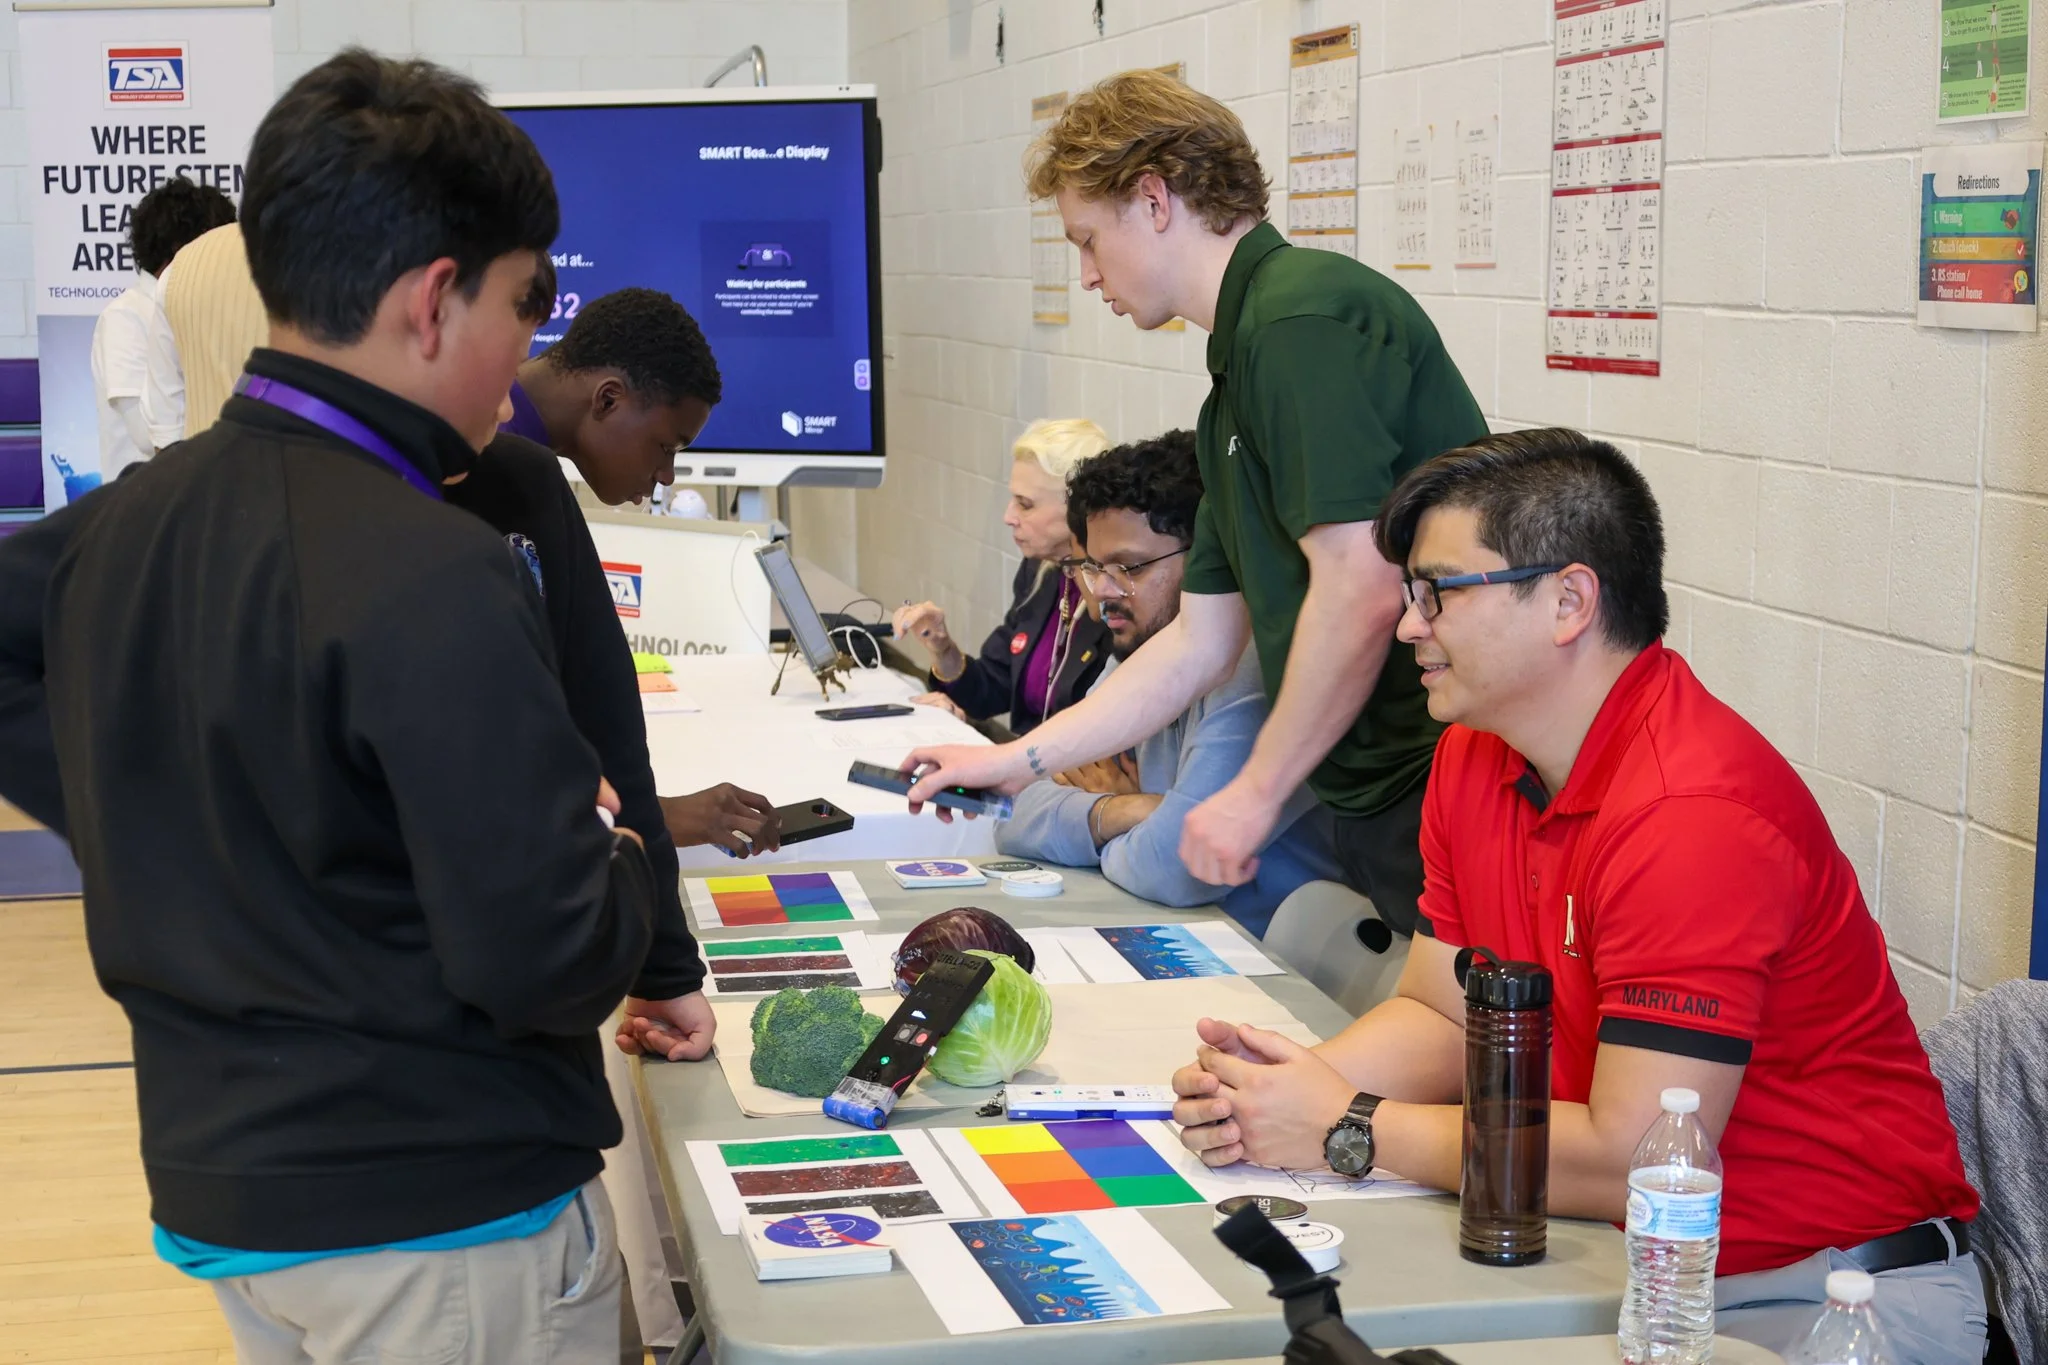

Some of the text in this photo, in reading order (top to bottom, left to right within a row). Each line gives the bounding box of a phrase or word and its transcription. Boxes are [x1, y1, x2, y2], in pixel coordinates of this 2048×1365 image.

[1943, 20, 1950, 37] 3
[1943, 55, 1950, 72] 4
[110, 60, 182, 90] TSA
[90, 125, 206, 154] WHERE
[699, 146, 742, 160] SMART
[785, 145, 830, 161] Display
[43, 164, 166, 194] FUTURE
[1957, 174, 2000, 190] Redirections
[82, 204, 134, 233] LEA
[1939, 210, 1963, 226] Warning
[1932, 240, 1938, 254] 2.
[72, 242, 134, 271] ARE
[551, 253, 568, 267] ad
[1931, 268, 1938, 282] 3.
[1946, 269, 1966, 282] station
[48, 286, 126, 299] TECHNOLOGY
[726, 279, 807, 290] Waiting for participants
[1936, 284, 1983, 299] Phone call home
[804, 416, 838, 427] SMART
[626, 633, 728, 656] HNOLOGY
[1622, 985, 1720, 1019] MARYLAND
[802, 1215, 843, 1247] NASA
[1287, 1229, 1326, 1240] VEST
